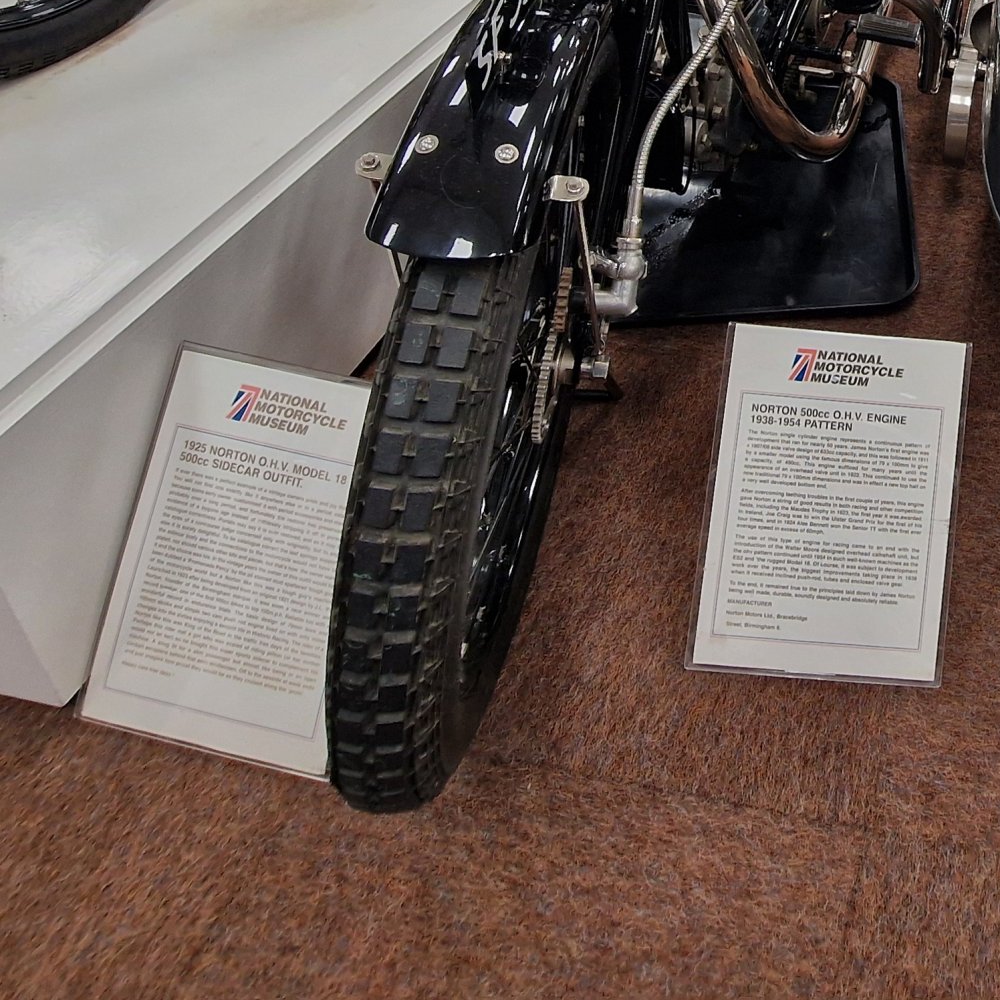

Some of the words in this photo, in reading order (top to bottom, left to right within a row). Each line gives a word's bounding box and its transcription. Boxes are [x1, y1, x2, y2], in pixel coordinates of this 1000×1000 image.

[817, 350, 884, 365] NATIONAL
[810, 373, 870, 387] MUSEUM
[813, 361, 905, 378] MOTORCYCLE
[259, 389, 328, 413] NATIONAL
[248, 413, 309, 436] MUSEUM
[254, 401, 348, 431] MOTORCYCLE
[750, 415, 801, 427] 1938-1954
[804, 419, 853, 432] PATTERN
[751, 403, 798, 416] NORTON
[800, 407, 830, 419] 500cc
[833, 410, 863, 422] O.H.V.
[866, 413, 908, 425] ENGINE
[179, 452, 209, 467] 500cc
[211, 460, 261, 479] SIDECAR
[263, 470, 304, 489] OUTFIT.
[183, 440, 207, 453] 1925
[209, 444, 257, 467] NORTON
[259, 456, 289, 472] O.H.V.
[292, 464, 331, 482] MODEL
[335, 474, 348, 485] 18
